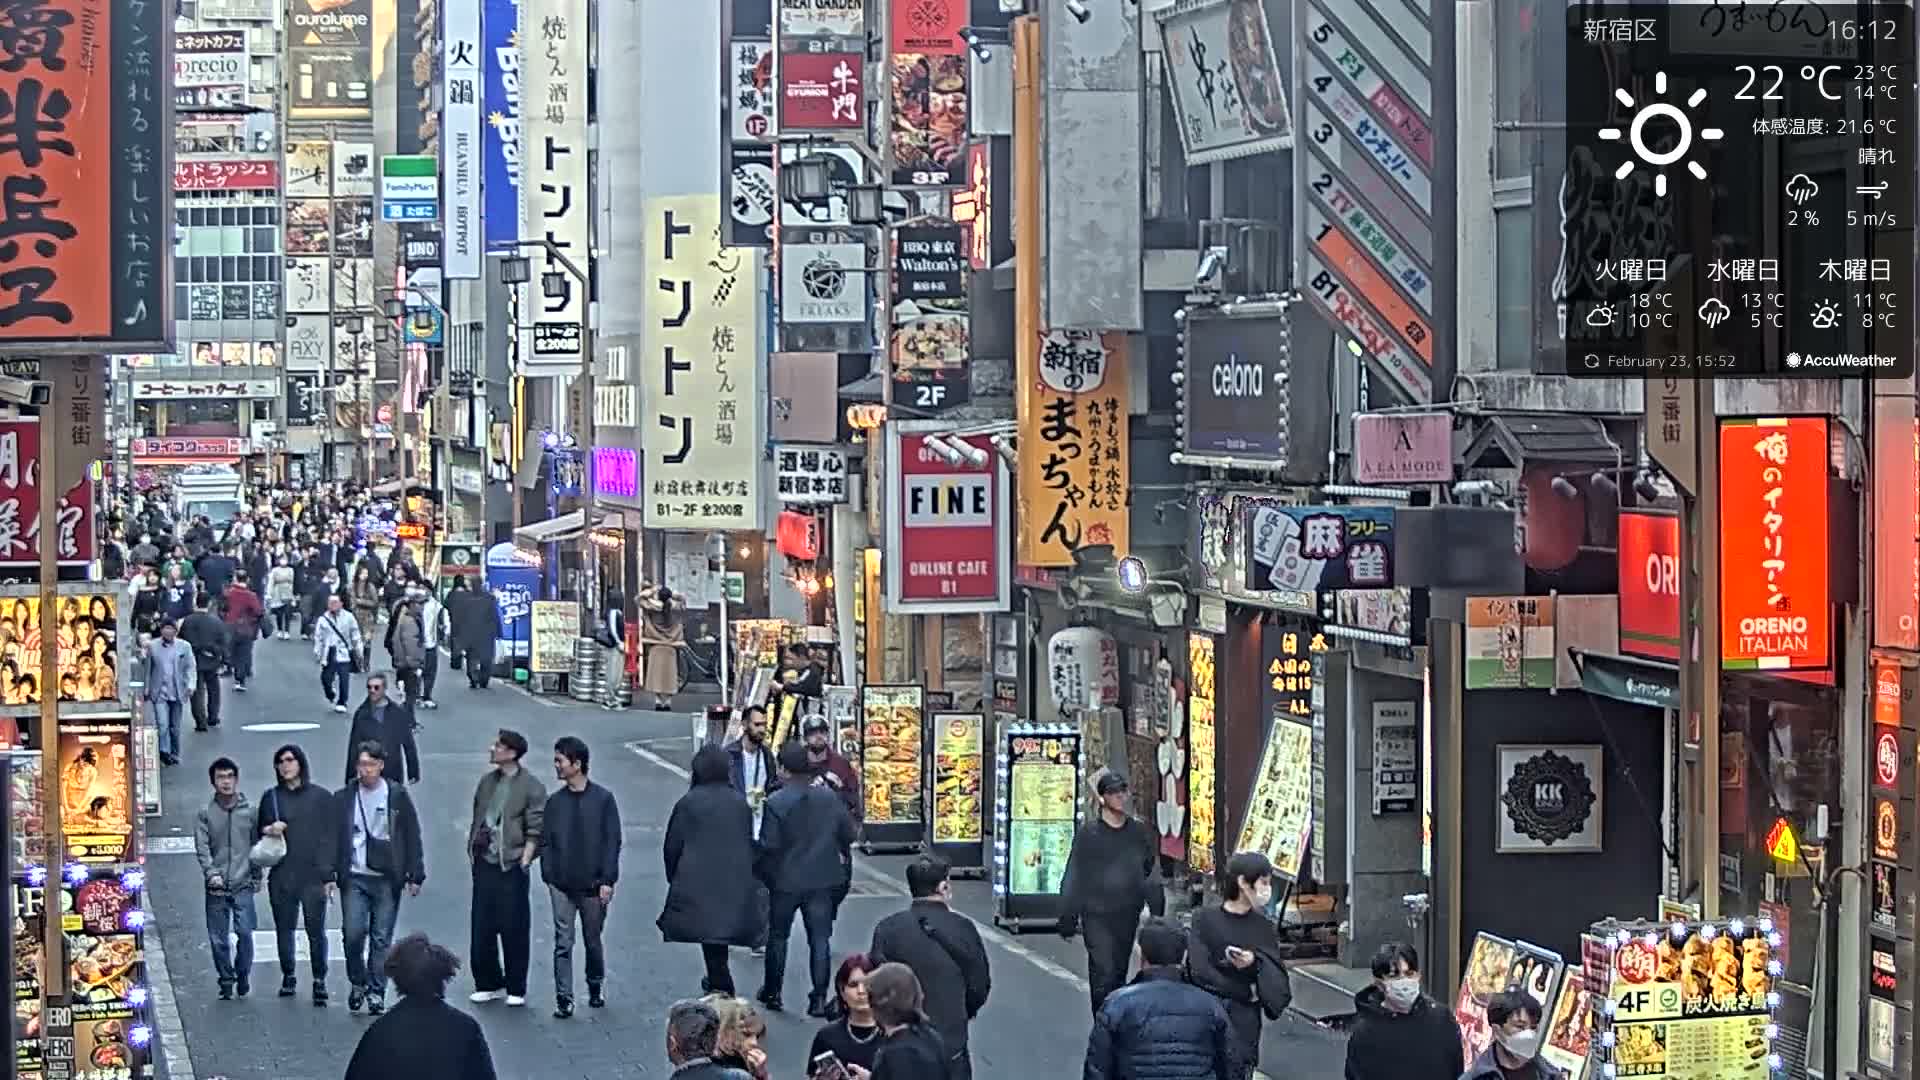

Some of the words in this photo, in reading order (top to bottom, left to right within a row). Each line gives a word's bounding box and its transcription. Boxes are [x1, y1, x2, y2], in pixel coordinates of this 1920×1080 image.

[295, 13, 368, 27] auralume
[1313, 23, 1335, 44] 5
[450, 40, 474, 104] 火鍋
[830, 60, 858, 121] 牛門
[1313, 75, 1333, 93] 4
[1314, 123, 1334, 144] 3
[912, 172, 949, 184] 3F
[1312, 173, 1333, 195] 2
[1316, 223, 1333, 242] 1
[901, 256, 958, 272] Walton's
[1311, 271, 1340, 300] B1
[659, 210, 692, 464] トントン
[1043, 344, 1102, 375] 新宿
[1063, 374, 1084, 390] の
[1212, 354, 1263, 396] celona
[916, 386, 946, 406] 2F
[1394, 423, 1413, 450] A
[779, 450, 844, 473] 酒場心
[1039, 397, 1086, 549] まっちゃん
[778, 475, 843, 495] 新宿本店
[911, 486, 985, 514] FINE
[1349, 520, 1390, 535] フリー
[1753, 431, 1788, 606] 俺のイタリアン
[909, 561, 953, 577] ONLINE
[957, 561, 988, 576] CAFE
[1739, 616, 1808, 634] ORENO
[1739, 635, 1808, 653] ITALIAN
[1535, 784, 1563, 799] KK
[1618, 991, 1650, 1013] 4F
[1685, 991, 1767, 1015] 炭火焼き鳥
